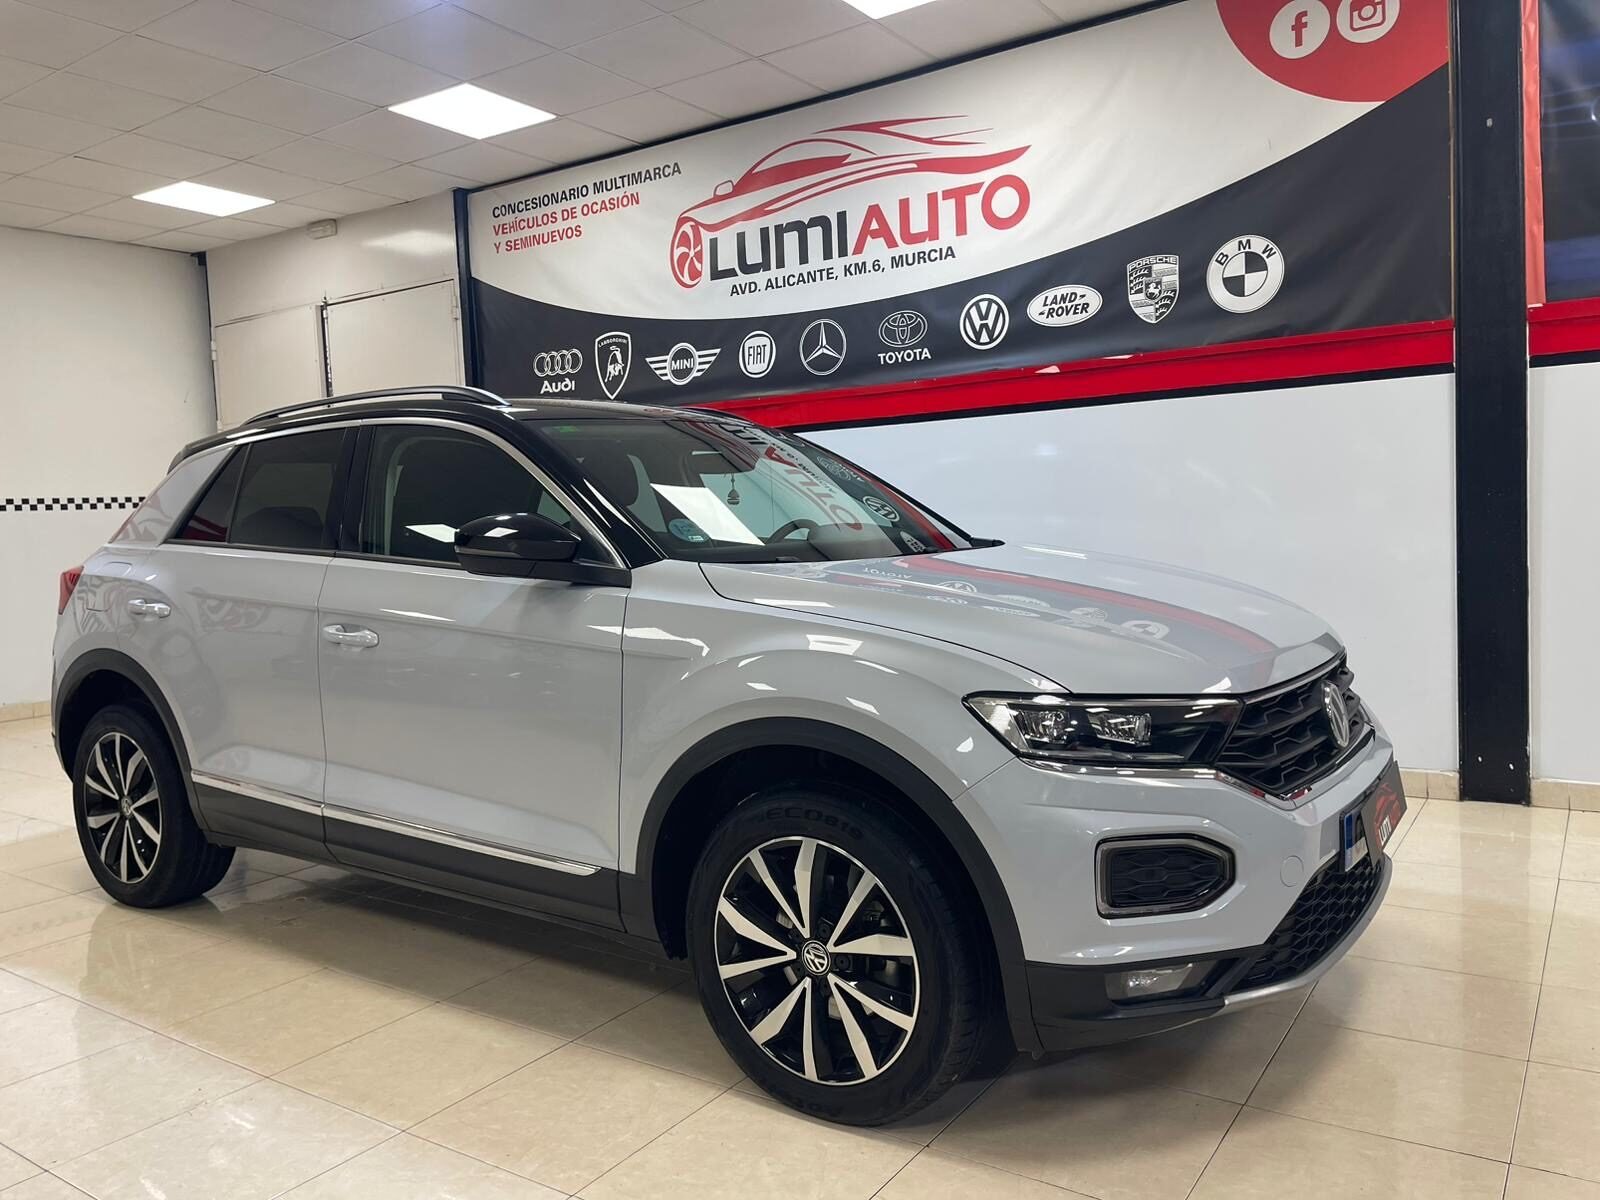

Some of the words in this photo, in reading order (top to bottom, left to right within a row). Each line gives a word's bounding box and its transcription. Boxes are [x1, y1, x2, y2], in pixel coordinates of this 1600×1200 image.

[492, 184, 589, 218] CONCESIONARIO
[593, 162, 682, 195] MULTIMARCA
[493, 211, 558, 236] VEHÍCULOS
[561, 207, 578, 222] DE
[581, 190, 640, 217] OCASIÓN
[493, 242, 502, 254] Y
[505, 224, 583, 252] SEMINUEVOS
[1214, 239, 1277, 266] BMW
[730, 281, 761, 297] AVD.
[764, 267, 839, 291] ALICANTE,
[843, 259, 885, 278] KM.6,
[890, 246, 956, 269] MURCIA
[1128, 256, 1177, 272] PORSCHE
[1043, 291, 1077, 307] LAND
[1046, 302, 1090, 319] ROVER
[748, 344, 767, 365] FIAT
[878, 348, 932, 365] TOYOTA
[671, 358, 694, 371] MINI
[540, 378, 576, 395] Audi
